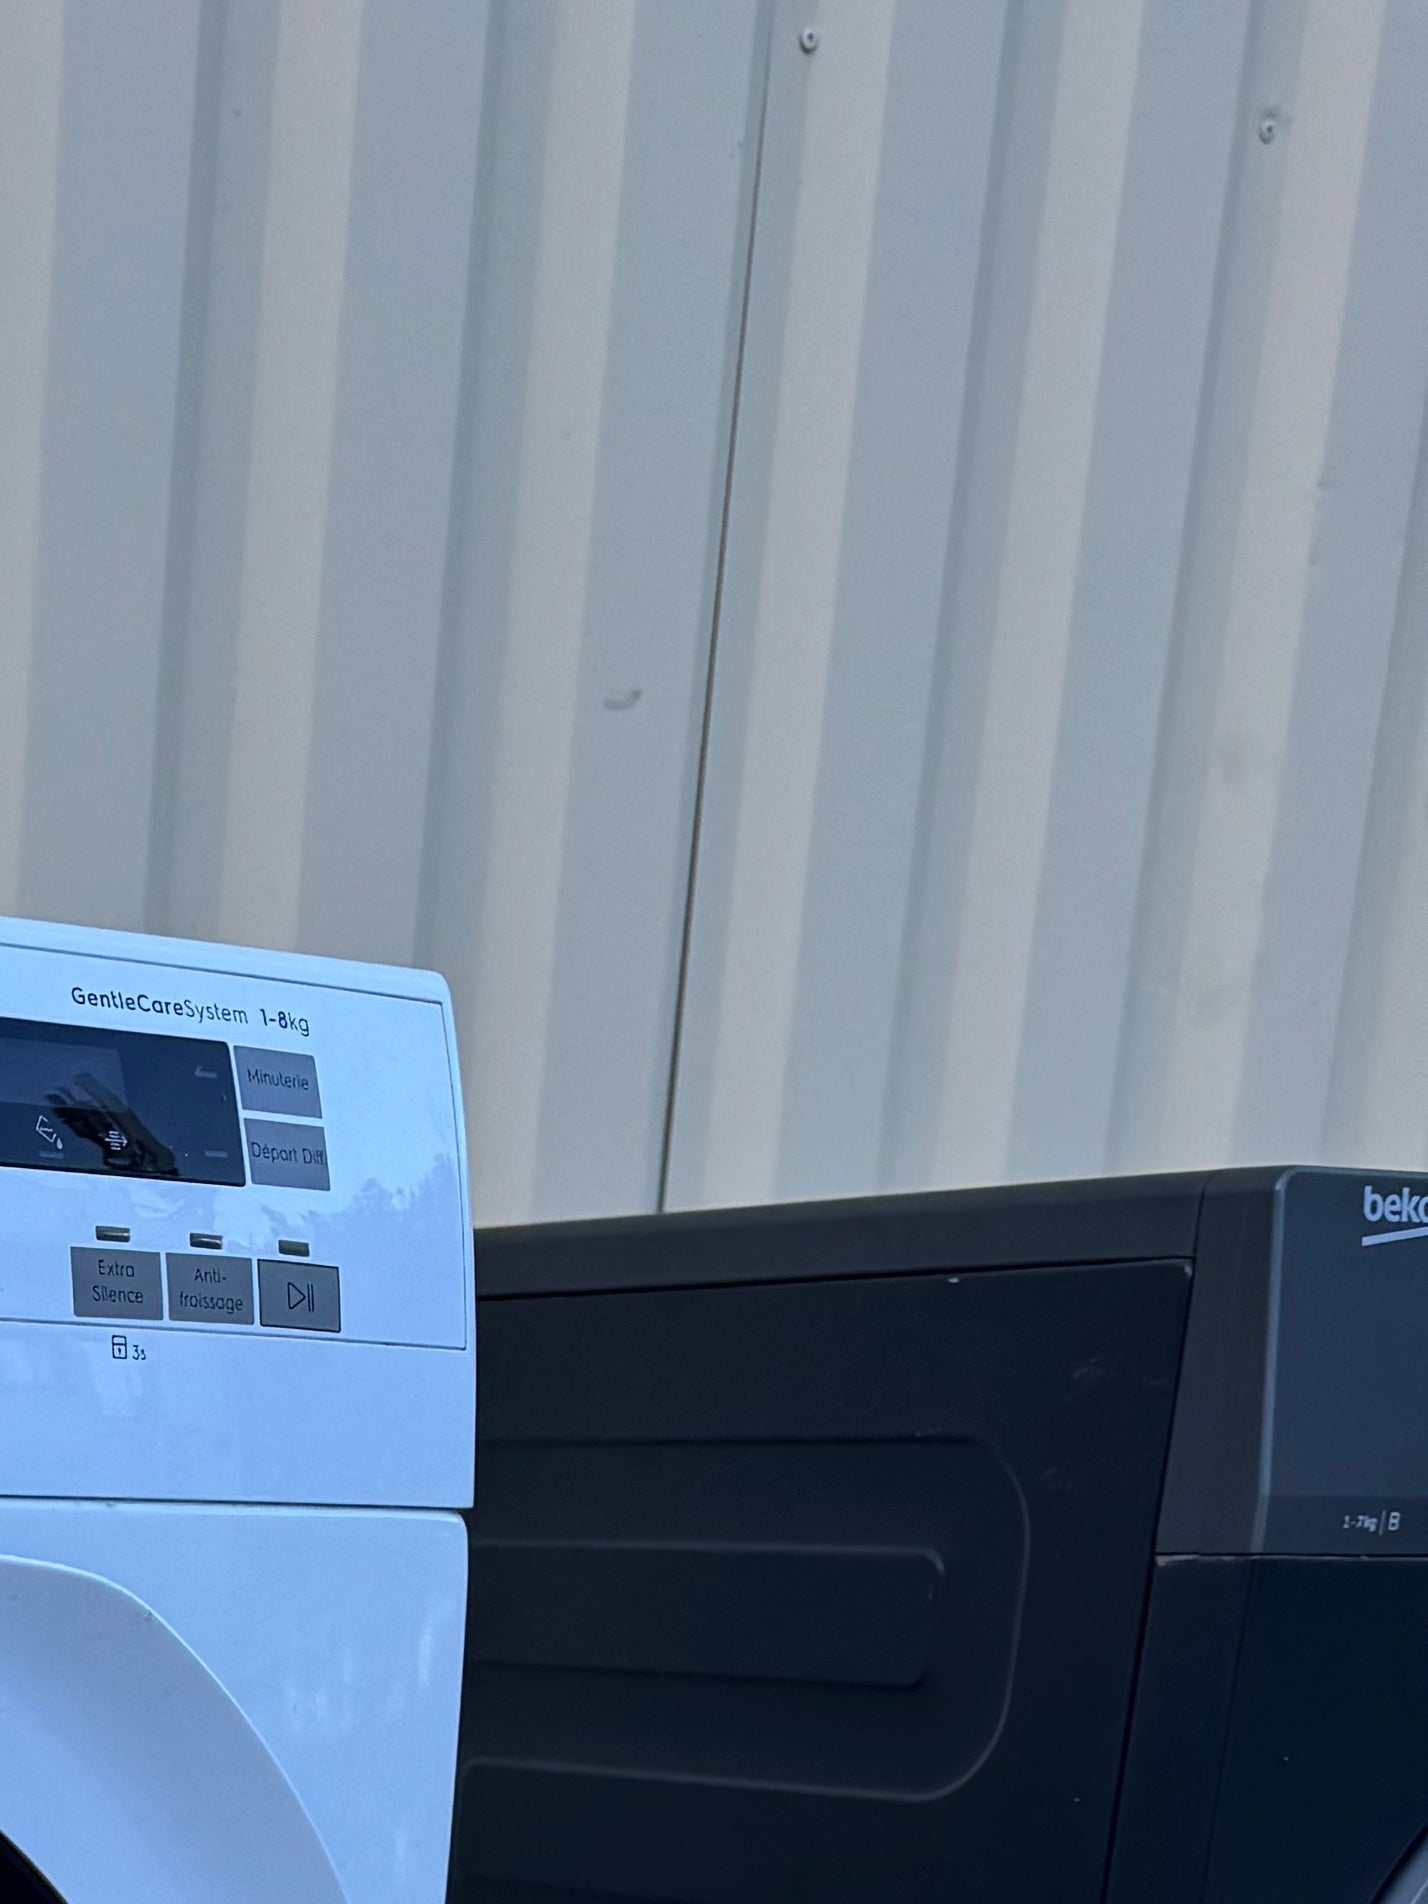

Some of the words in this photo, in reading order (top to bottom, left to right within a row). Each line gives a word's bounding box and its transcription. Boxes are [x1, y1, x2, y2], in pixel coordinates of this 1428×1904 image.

[71, 986, 249, 1024] GentleCareSystem
[259, 1007, 310, 1037] 1-8kg
[247, 1068, 310, 1092] Minuterie
[250, 1141, 298, 1163] Départ
[97, 1259, 135, 1278] Extra
[193, 1267, 227, 1284] Anti-
[92, 1285, 144, 1305] Silence
[179, 1291, 244, 1315] froissage
[131, 1344, 147, 1361] 3s
[1387, 1511, 1401, 1532] B
